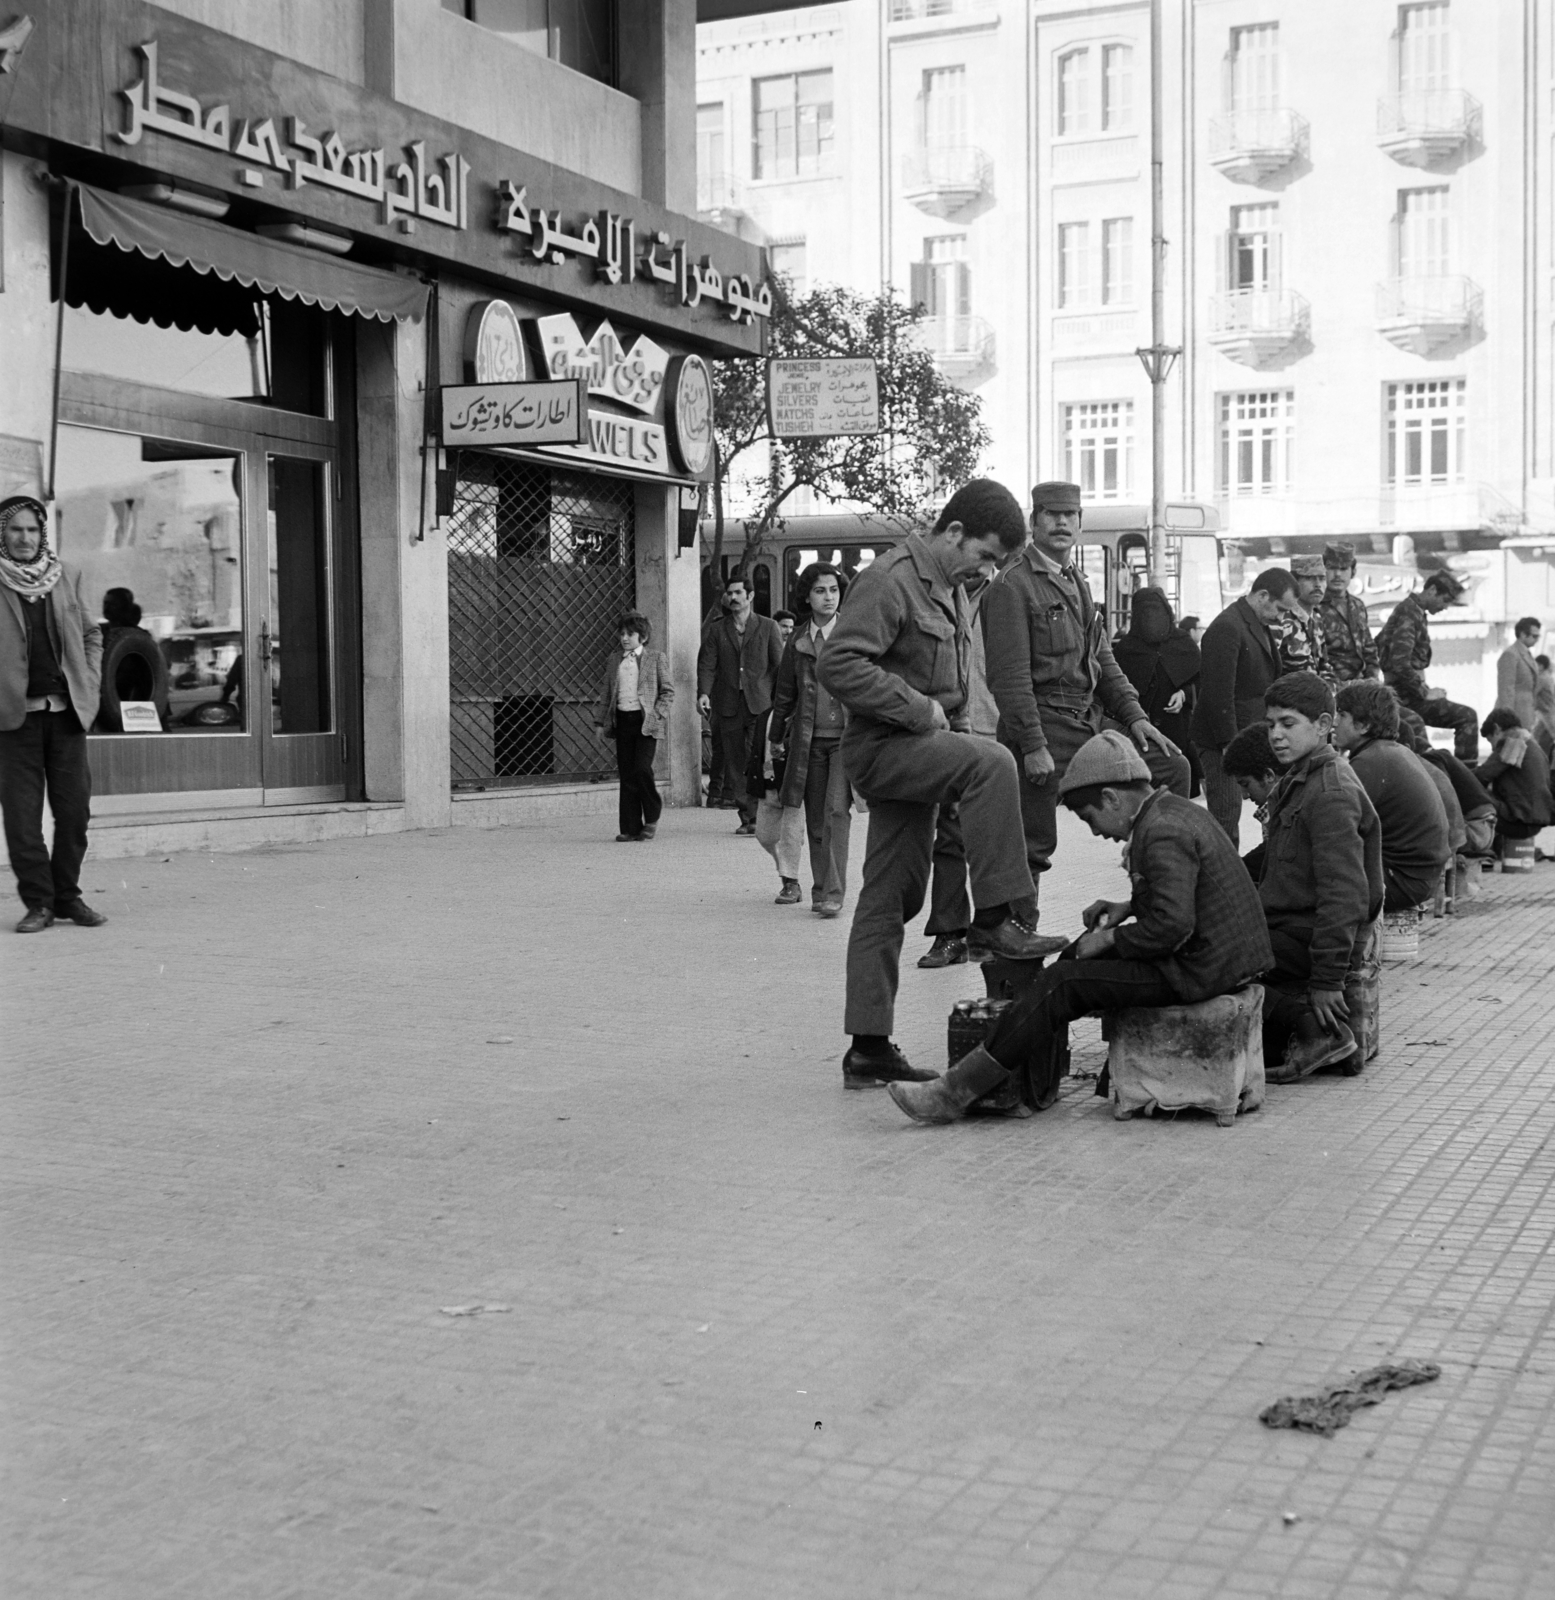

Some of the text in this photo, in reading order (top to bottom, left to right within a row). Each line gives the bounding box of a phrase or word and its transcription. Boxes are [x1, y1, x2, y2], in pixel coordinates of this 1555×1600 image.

[116, 40, 230, 152] مطر
[386, 141, 471, 234] الحاج
[645, 230, 772, 326] مجوهرات
[776, 362, 821, 374] PRINCESS
[776, 394, 818, 407] SILVERS
[837, 406, 874, 418] ساعات
[513, 397, 571, 430] اطارات
[775, 421, 814, 433] TUSHEH
